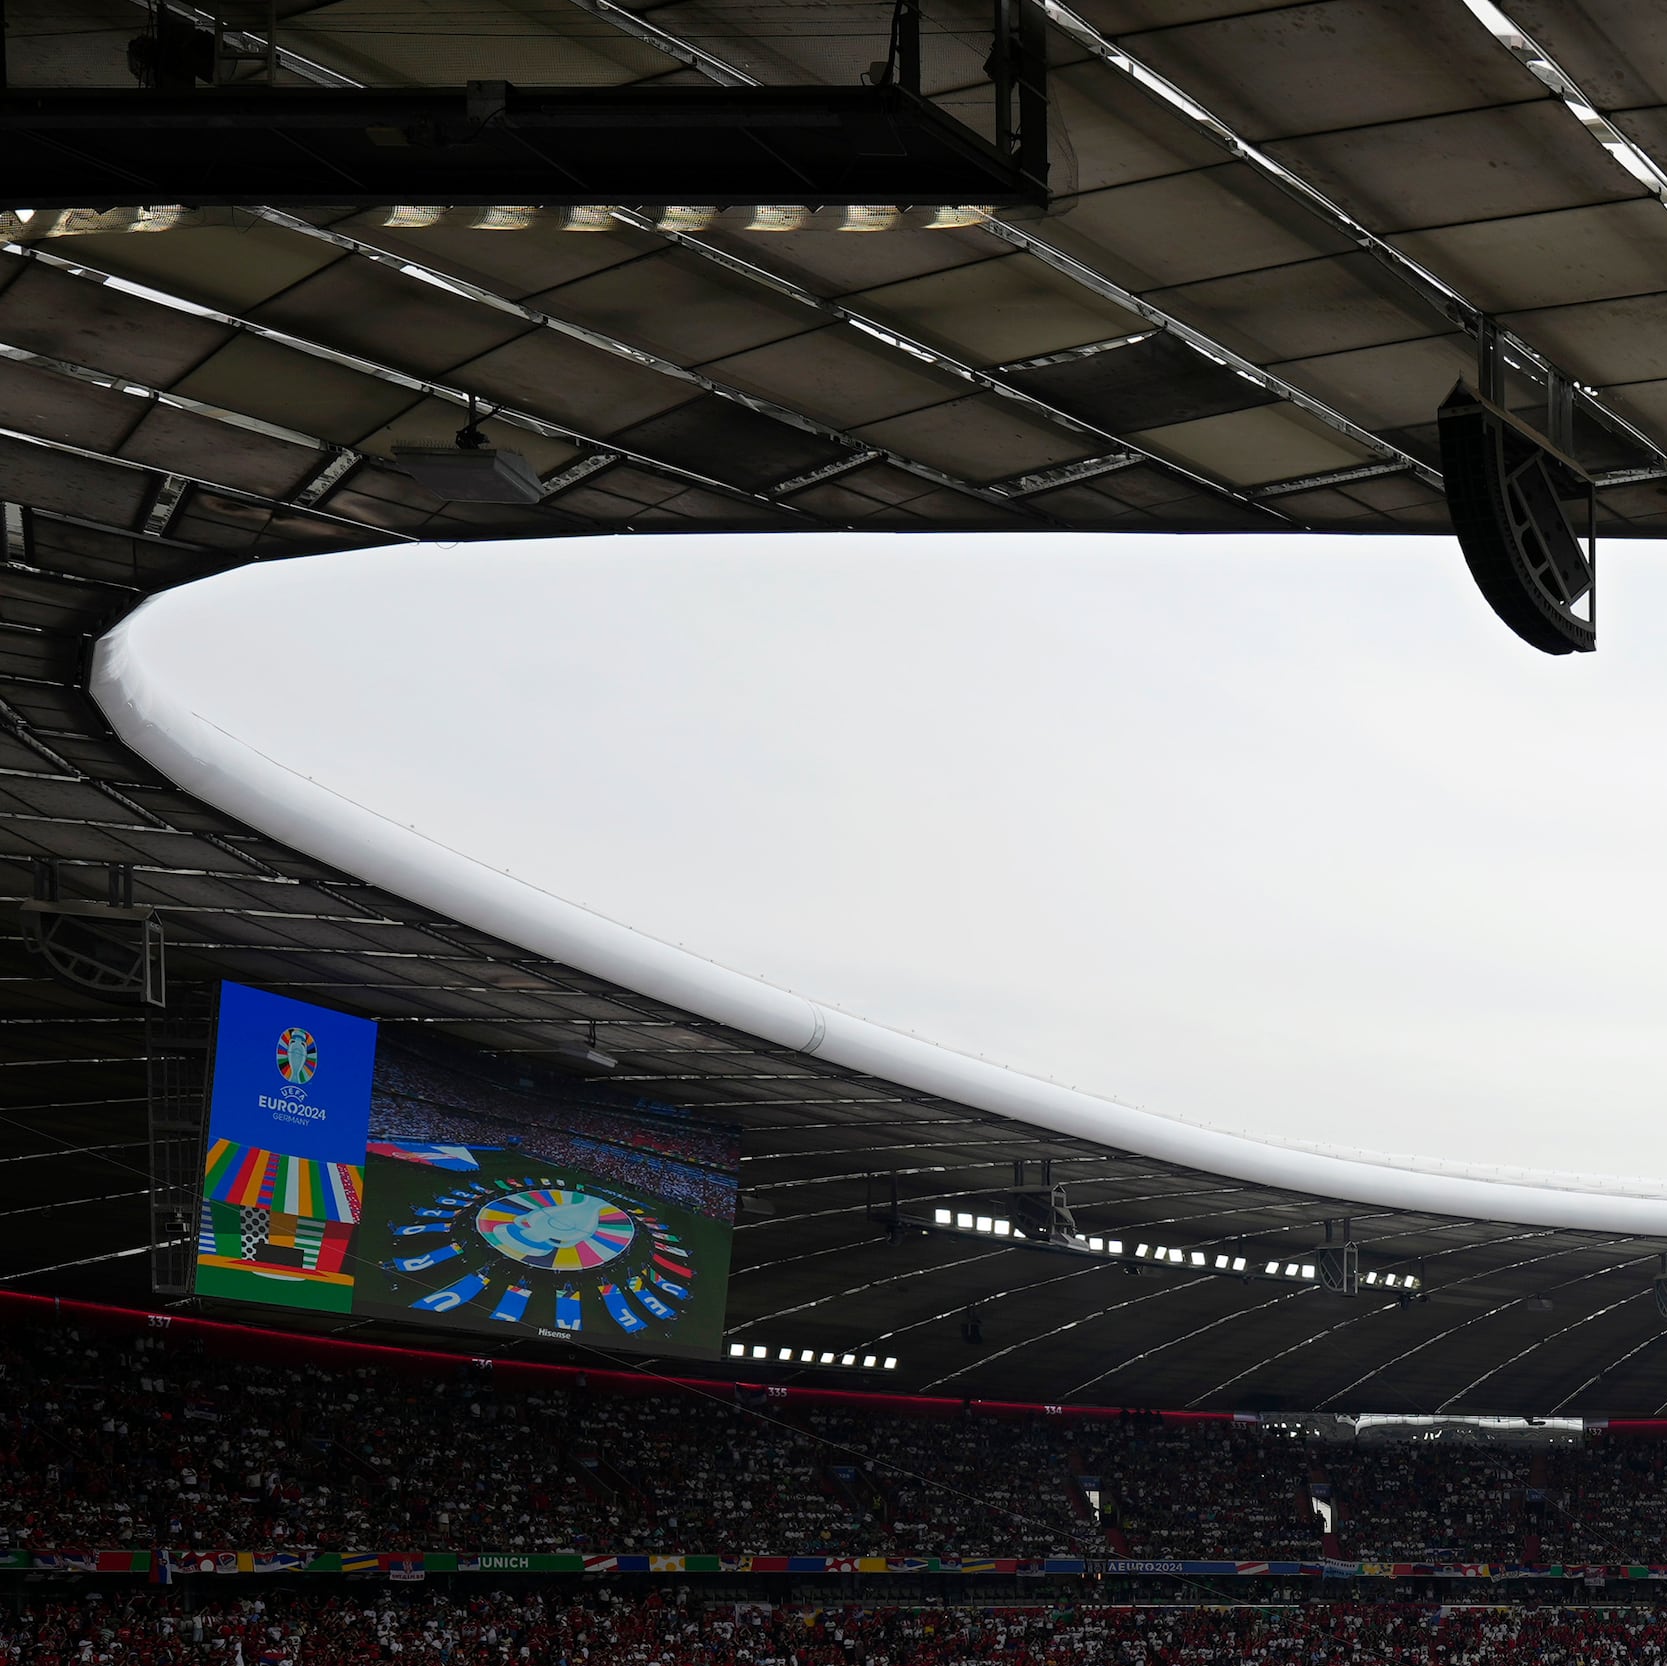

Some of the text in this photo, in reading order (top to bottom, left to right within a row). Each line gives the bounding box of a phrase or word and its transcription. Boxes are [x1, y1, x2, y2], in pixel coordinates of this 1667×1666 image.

[272, 1112, 310, 1126] GERMANY
[147, 1315, 172, 1329] 337
[538, 1327, 572, 1340] Hisense
[478, 1556, 529, 1568] UNICH
